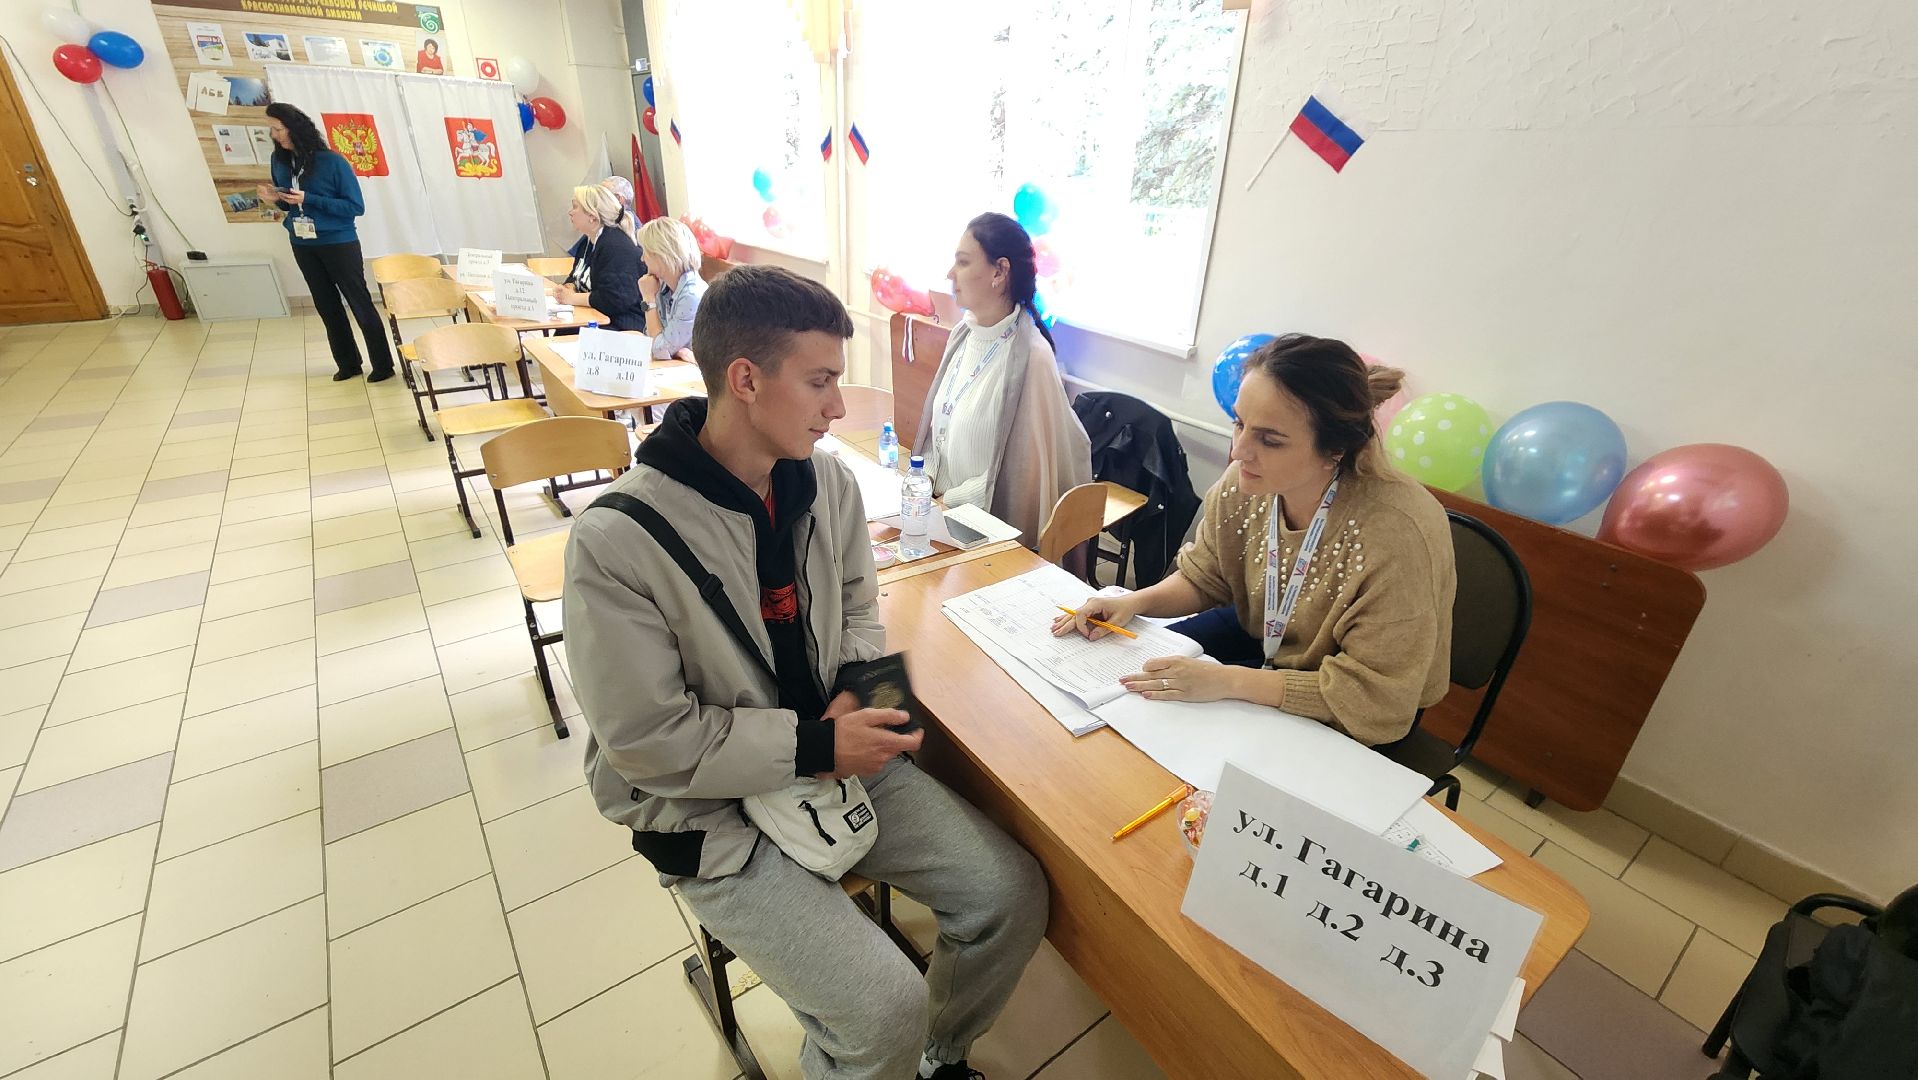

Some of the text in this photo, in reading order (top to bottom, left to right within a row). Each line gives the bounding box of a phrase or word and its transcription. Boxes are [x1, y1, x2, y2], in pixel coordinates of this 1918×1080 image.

[325, 8, 363, 20] ДИВИЗИИ
[583, 351, 643, 367] ул. Гагарина
[586, 366, 635, 382] д.8 д.10
[1232, 809, 1283, 850] ул.
[1293, 835, 1491, 964] Гагарина
[1238, 860, 1445, 988] д.1 д.2 д.3
